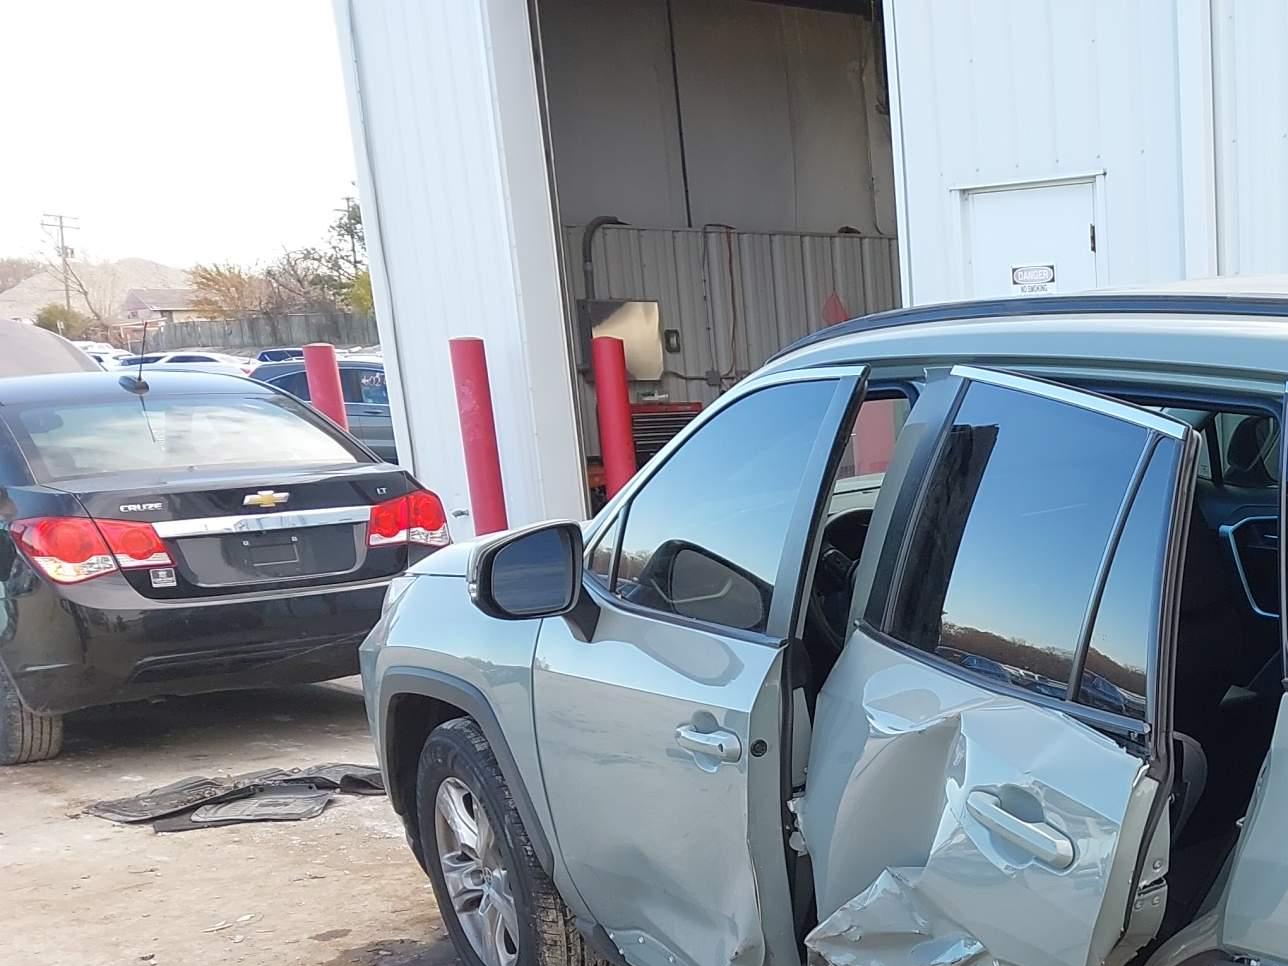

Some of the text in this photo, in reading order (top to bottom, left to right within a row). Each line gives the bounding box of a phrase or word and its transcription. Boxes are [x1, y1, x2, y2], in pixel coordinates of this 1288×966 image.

[1018, 269, 1049, 281] DANGER
[376, 487, 387, 495] LT
[119, 502, 163, 512] CRUZE
